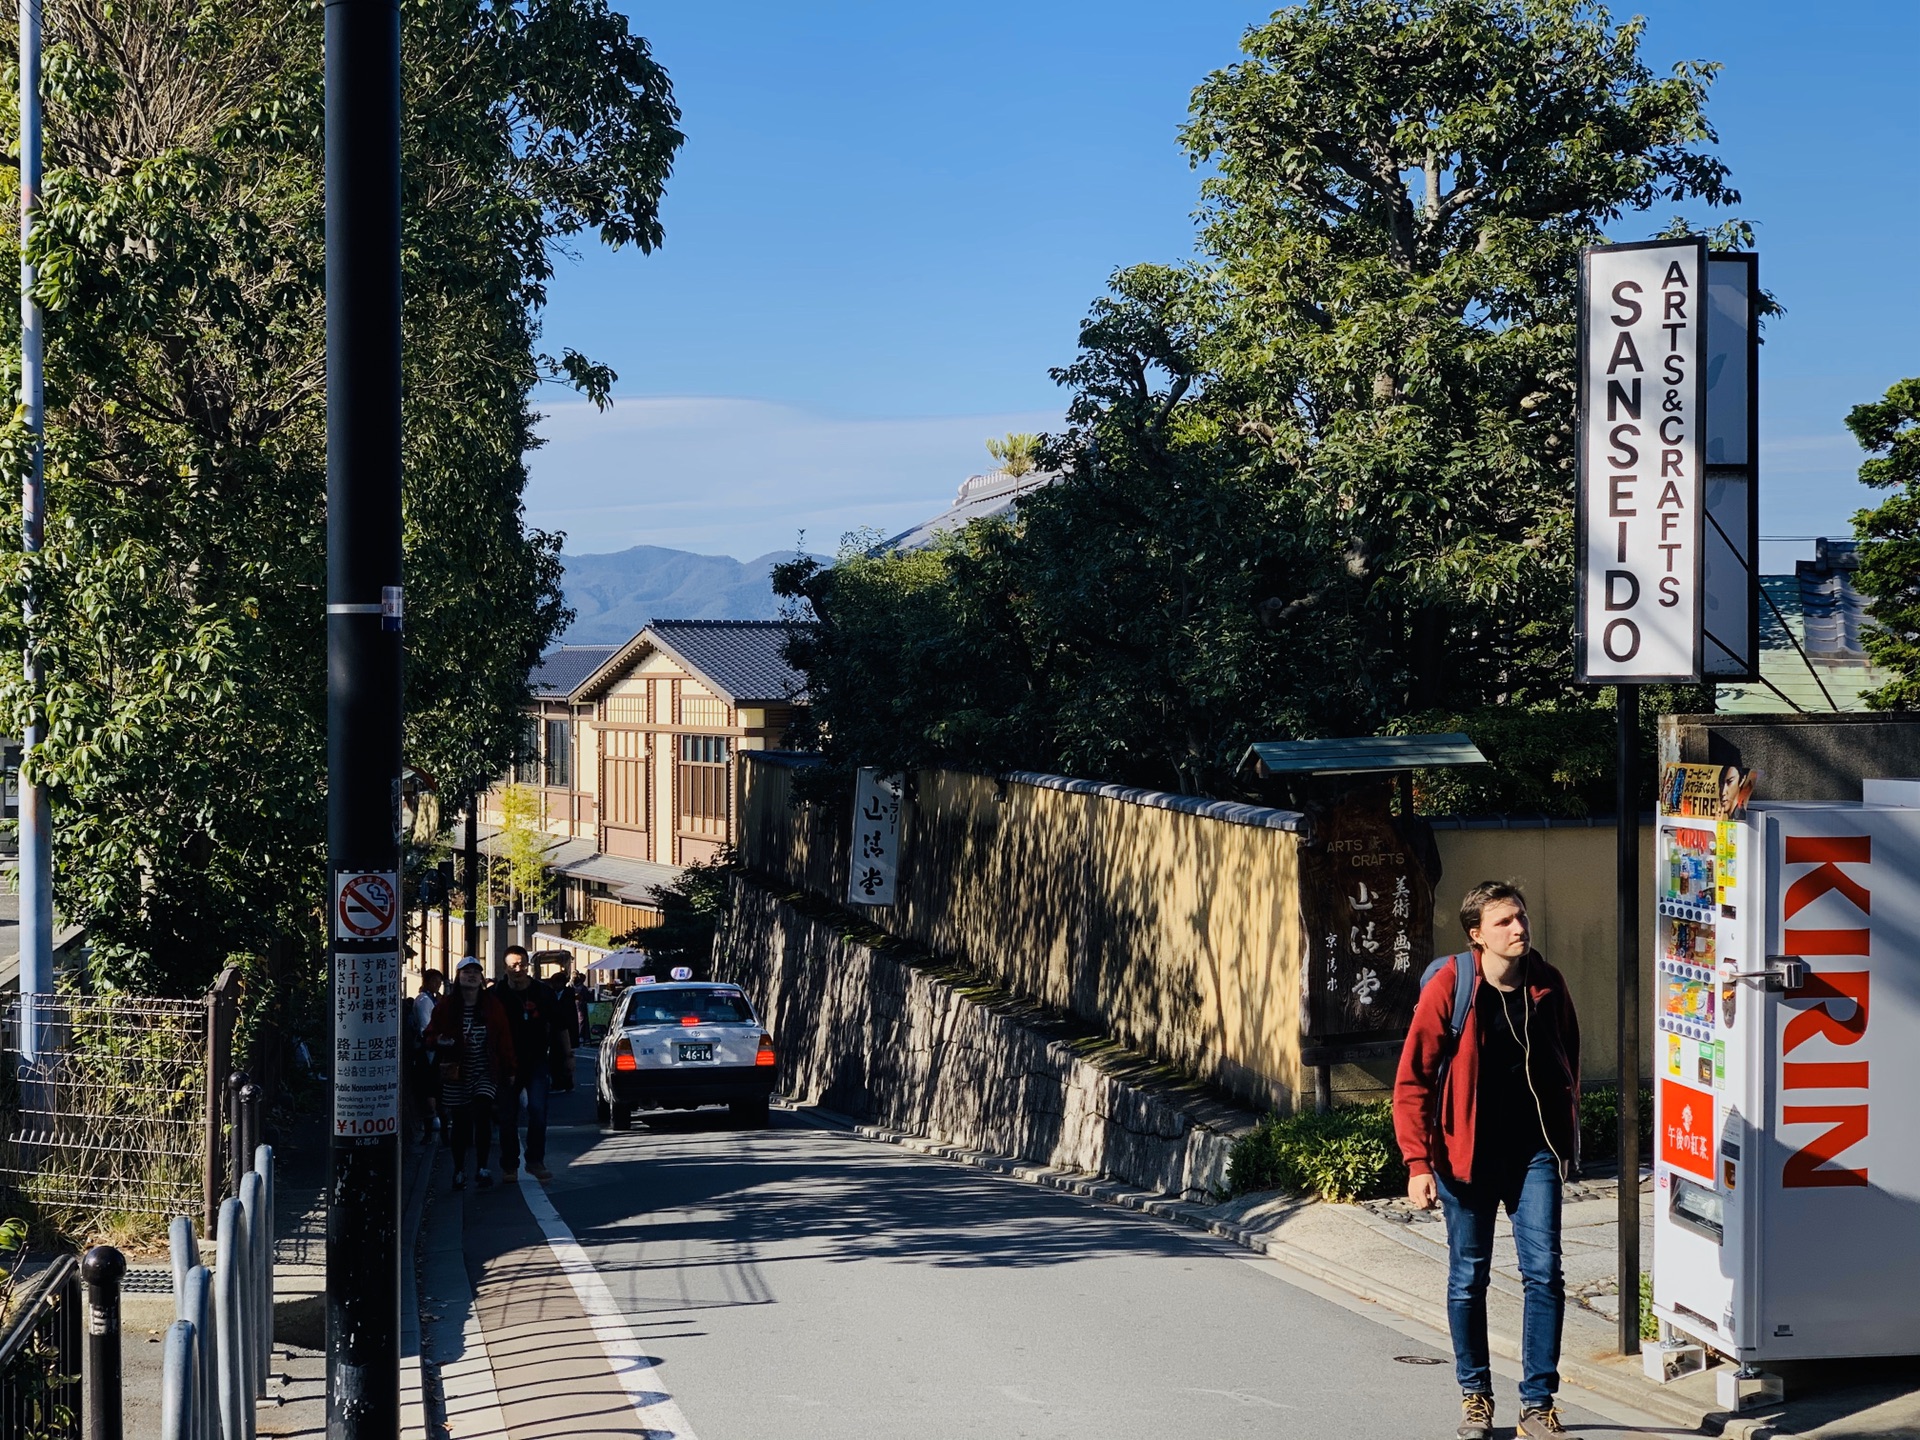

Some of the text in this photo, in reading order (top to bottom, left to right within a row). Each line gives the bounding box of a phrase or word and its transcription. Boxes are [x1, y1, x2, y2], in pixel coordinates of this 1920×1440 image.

[1602, 279, 1645, 664] SANSEIDO
[889, 779, 902, 835] ギャラリー
[1326, 838, 1363, 853] ARTS
[1675, 827, 1707, 854] KIRIN
[1351, 852, 1406, 868] CRAFTS
[336, 958, 347, 1030] 科されます。
[361, 958, 374, 1024] すると過料
[375, 958, 387, 1023] 路上喫煙を
[388, 957, 397, 1019] この区域で
[1783, 835, 1871, 1189] KIRIN
[336, 1035, 397, 1050] 路上吸烟
[336, 1049, 396, 1062] 禁止区域
[686, 1049, 712, 1060] 46-14
[335, 1083, 350, 1092] Public
[351, 1082, 387, 1092] Nonsmoking
[337, 1095, 363, 1103] Smoking
[336, 1116, 396, 1135] ¥1,000
[1667, 1125, 1707, 1160] 午後の紅茶
